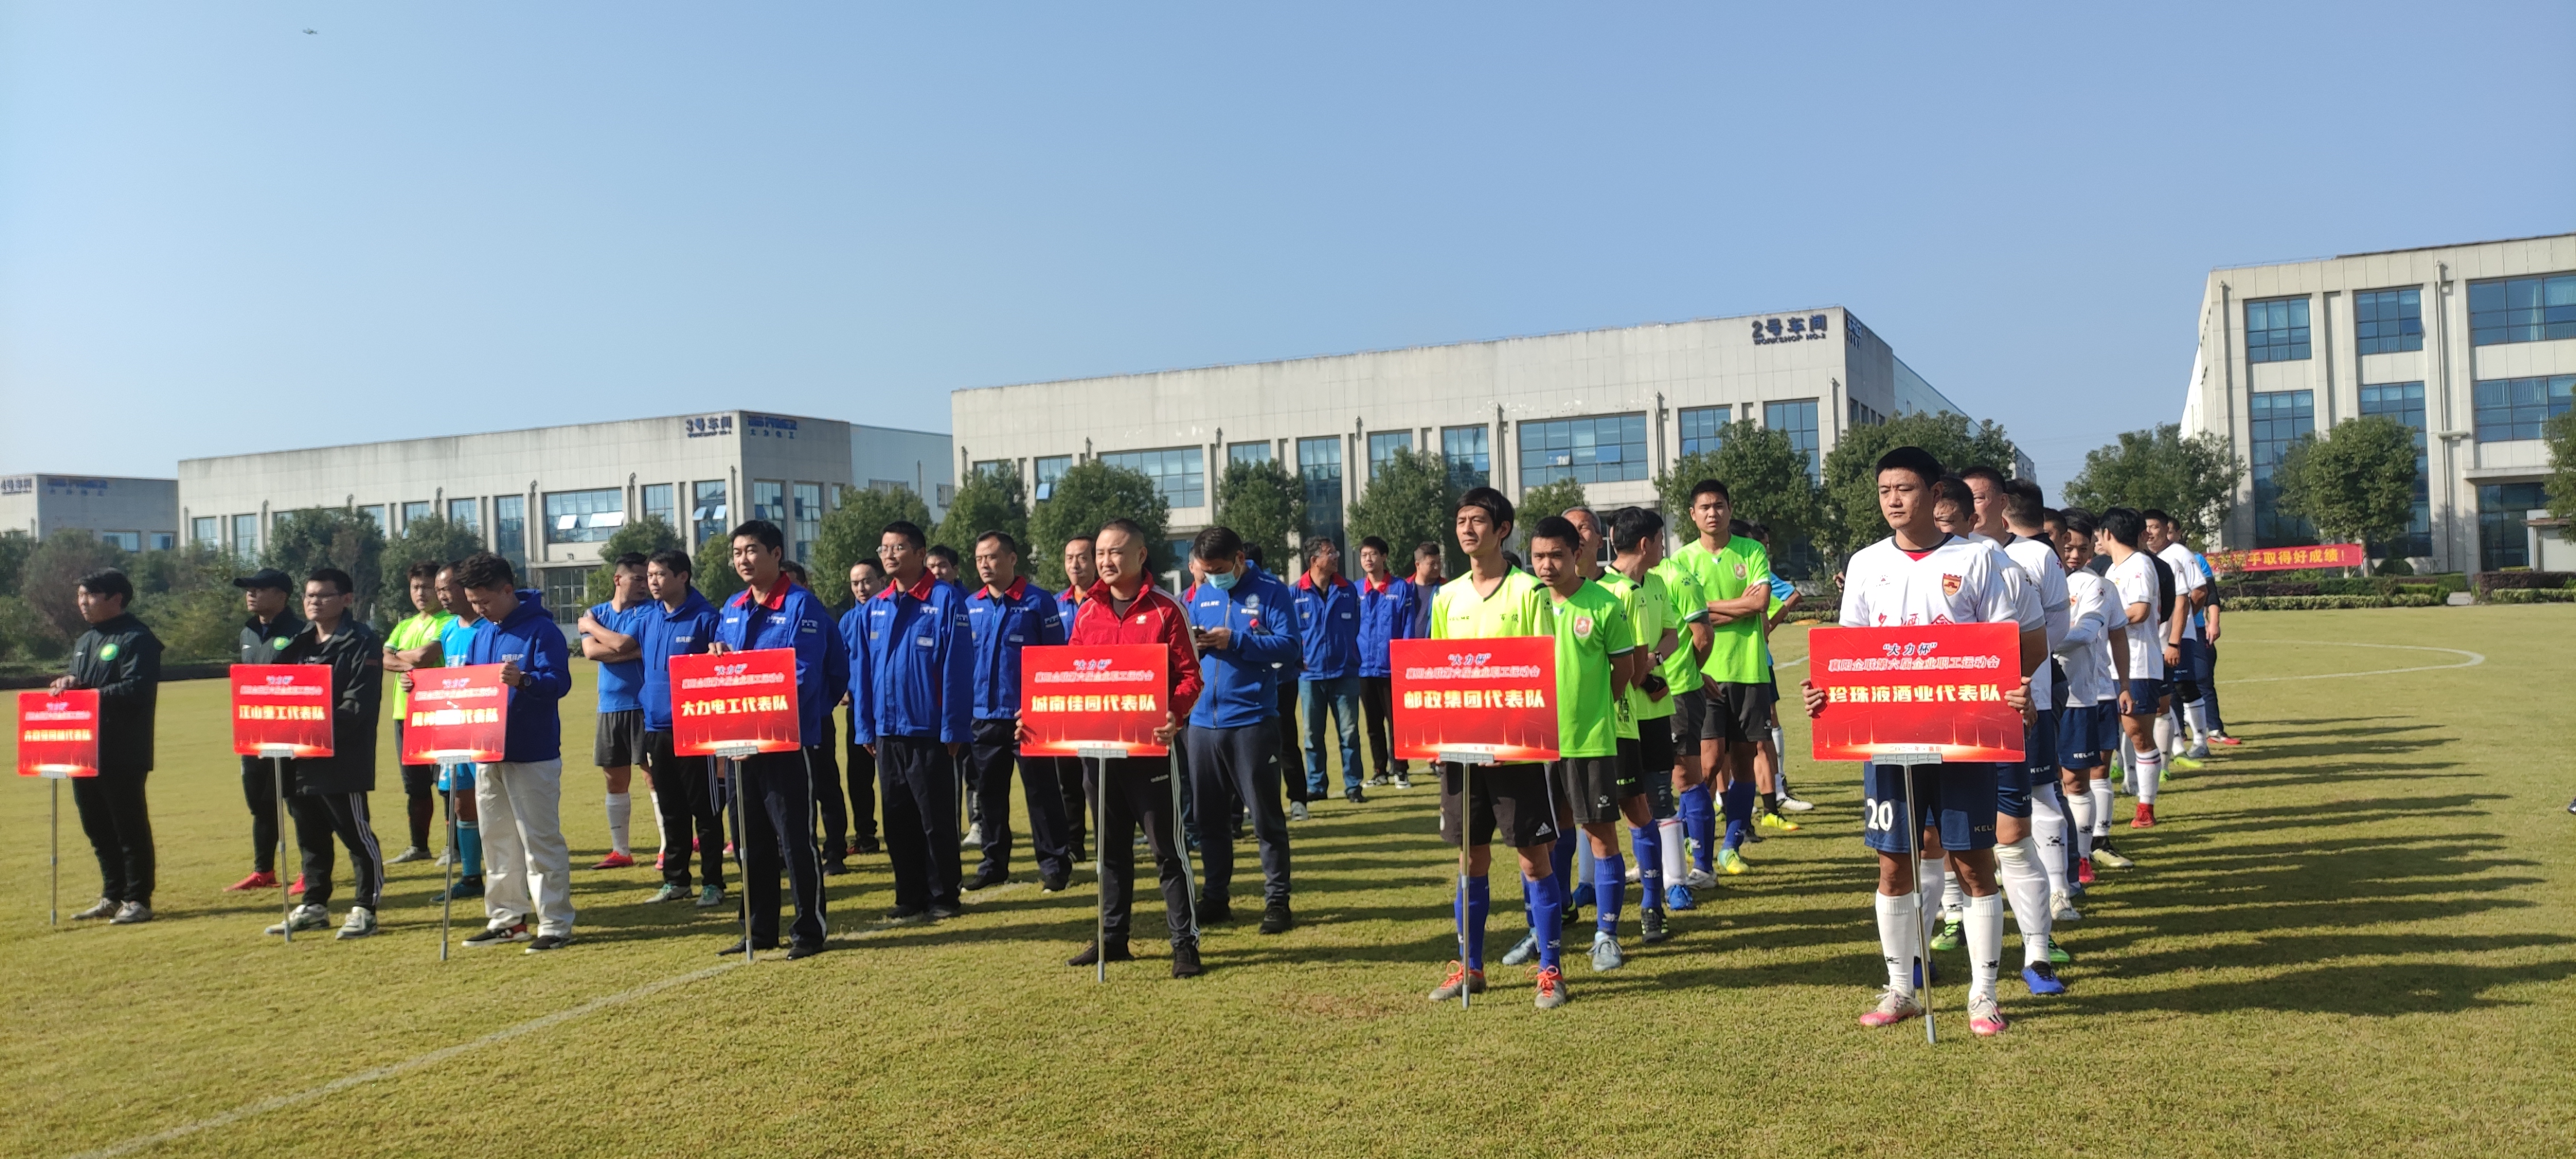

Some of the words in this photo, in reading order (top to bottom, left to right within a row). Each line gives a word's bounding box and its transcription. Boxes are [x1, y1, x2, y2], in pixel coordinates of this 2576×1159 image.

[1751, 314, 1827, 338] 2号车间
[1754, 335, 1803, 345] WORKSHOP
[1828, 655, 2000, 672] 襄阳企联第六届企业职工运动会
[1404, 689, 1545, 709] 邮政集团代表队
[1828, 684, 2001, 703] 珍珠液酒业代表队
[239, 704, 325, 720] 江山重工代表队
[681, 694, 789, 717] 大力电工代表队
[1031, 694, 1157, 712] 城南佳园代表队
[2030, 765, 2051, 774] KELME
[1867, 798, 1893, 831] 20
